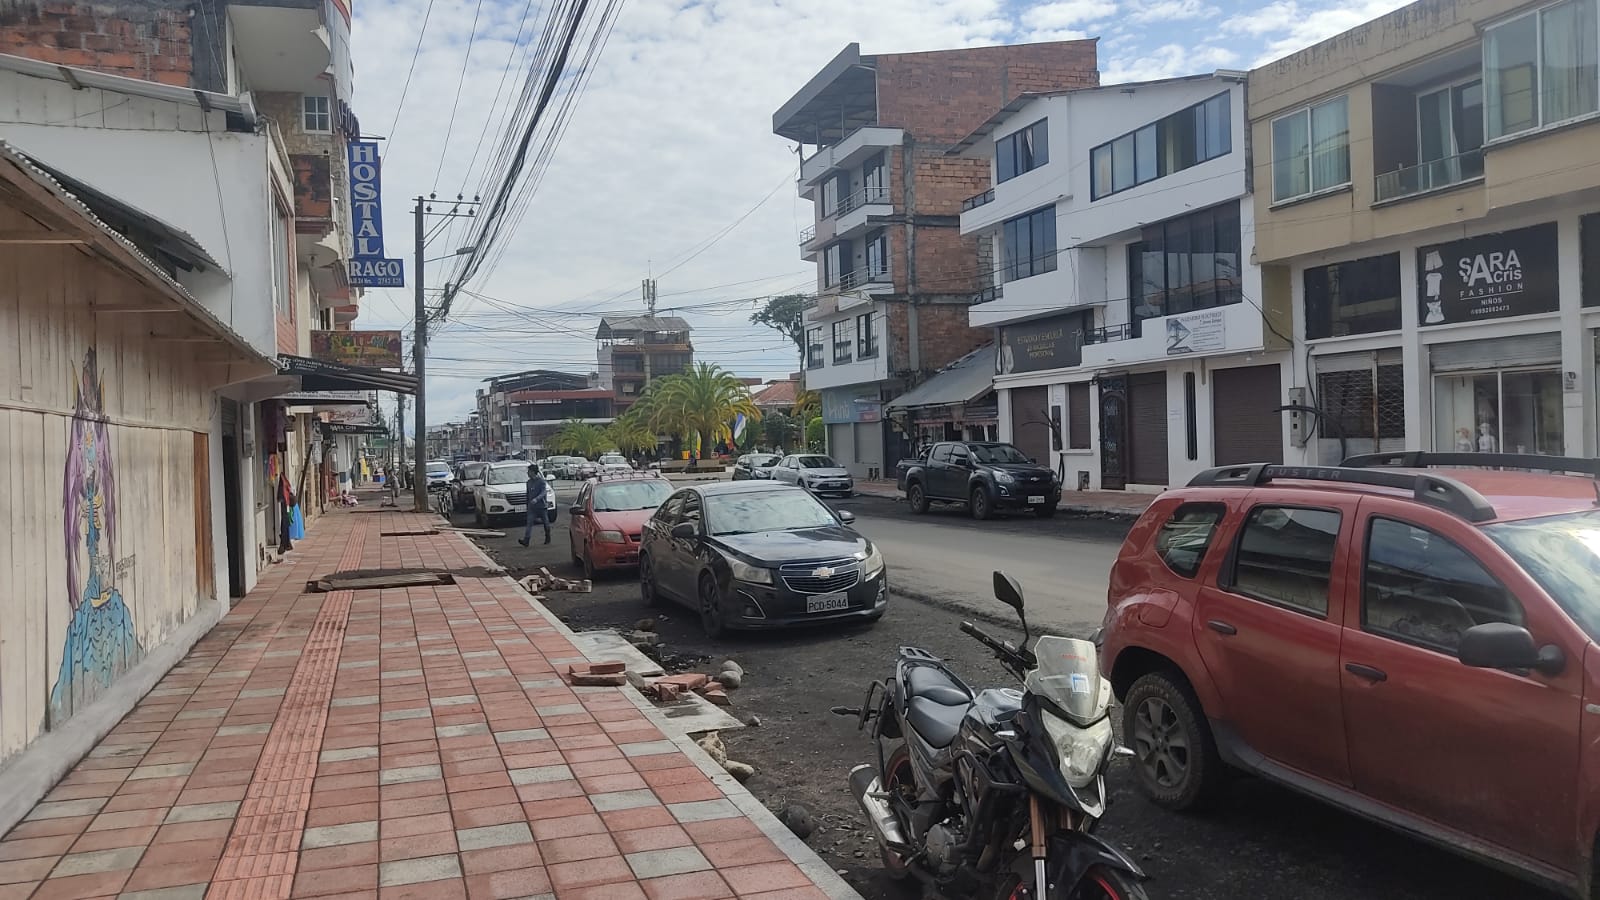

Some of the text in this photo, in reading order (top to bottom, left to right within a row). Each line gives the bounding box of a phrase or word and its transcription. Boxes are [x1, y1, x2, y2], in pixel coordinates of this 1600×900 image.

[352, 146, 380, 255] HOSTAL
[1458, 249, 1521, 287] SARA
[1460, 283, 1523, 297] FASHION
[1481, 297, 1503, 306] NIÑOS
[1266, 468, 1341, 478] DUSTER
[808, 599, 847, 611] PCD-5044
